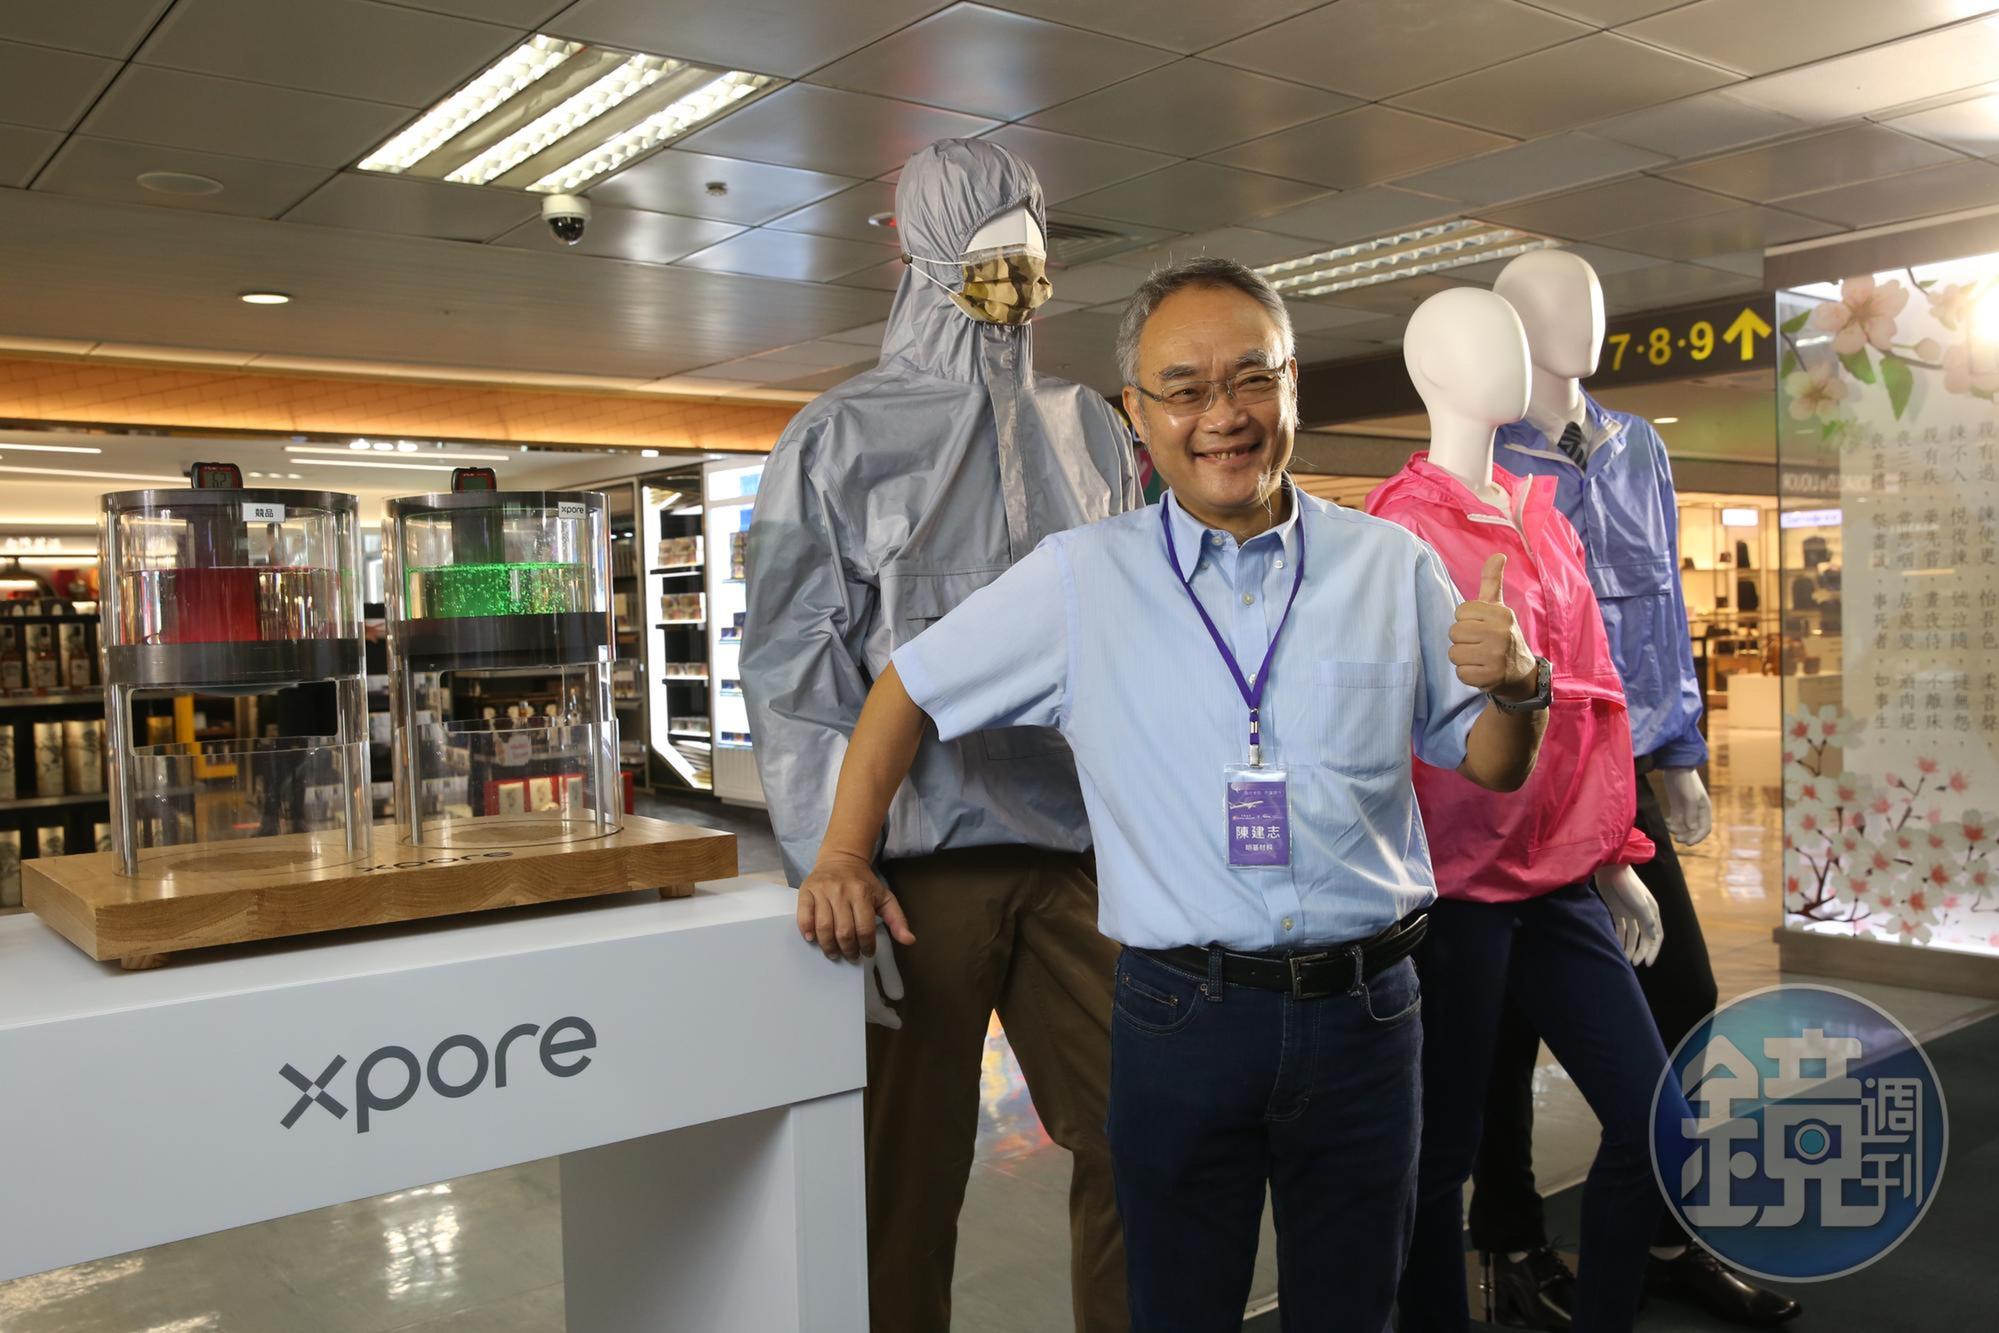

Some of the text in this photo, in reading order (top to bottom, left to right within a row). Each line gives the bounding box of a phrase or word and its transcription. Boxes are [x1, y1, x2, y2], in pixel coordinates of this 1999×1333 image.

[561, 506, 584, 514] xpore
[1236, 825, 1281, 839] 陳建志
[356, 851, 513, 872] xpore
[278, 1016, 597, 1134] xpore
